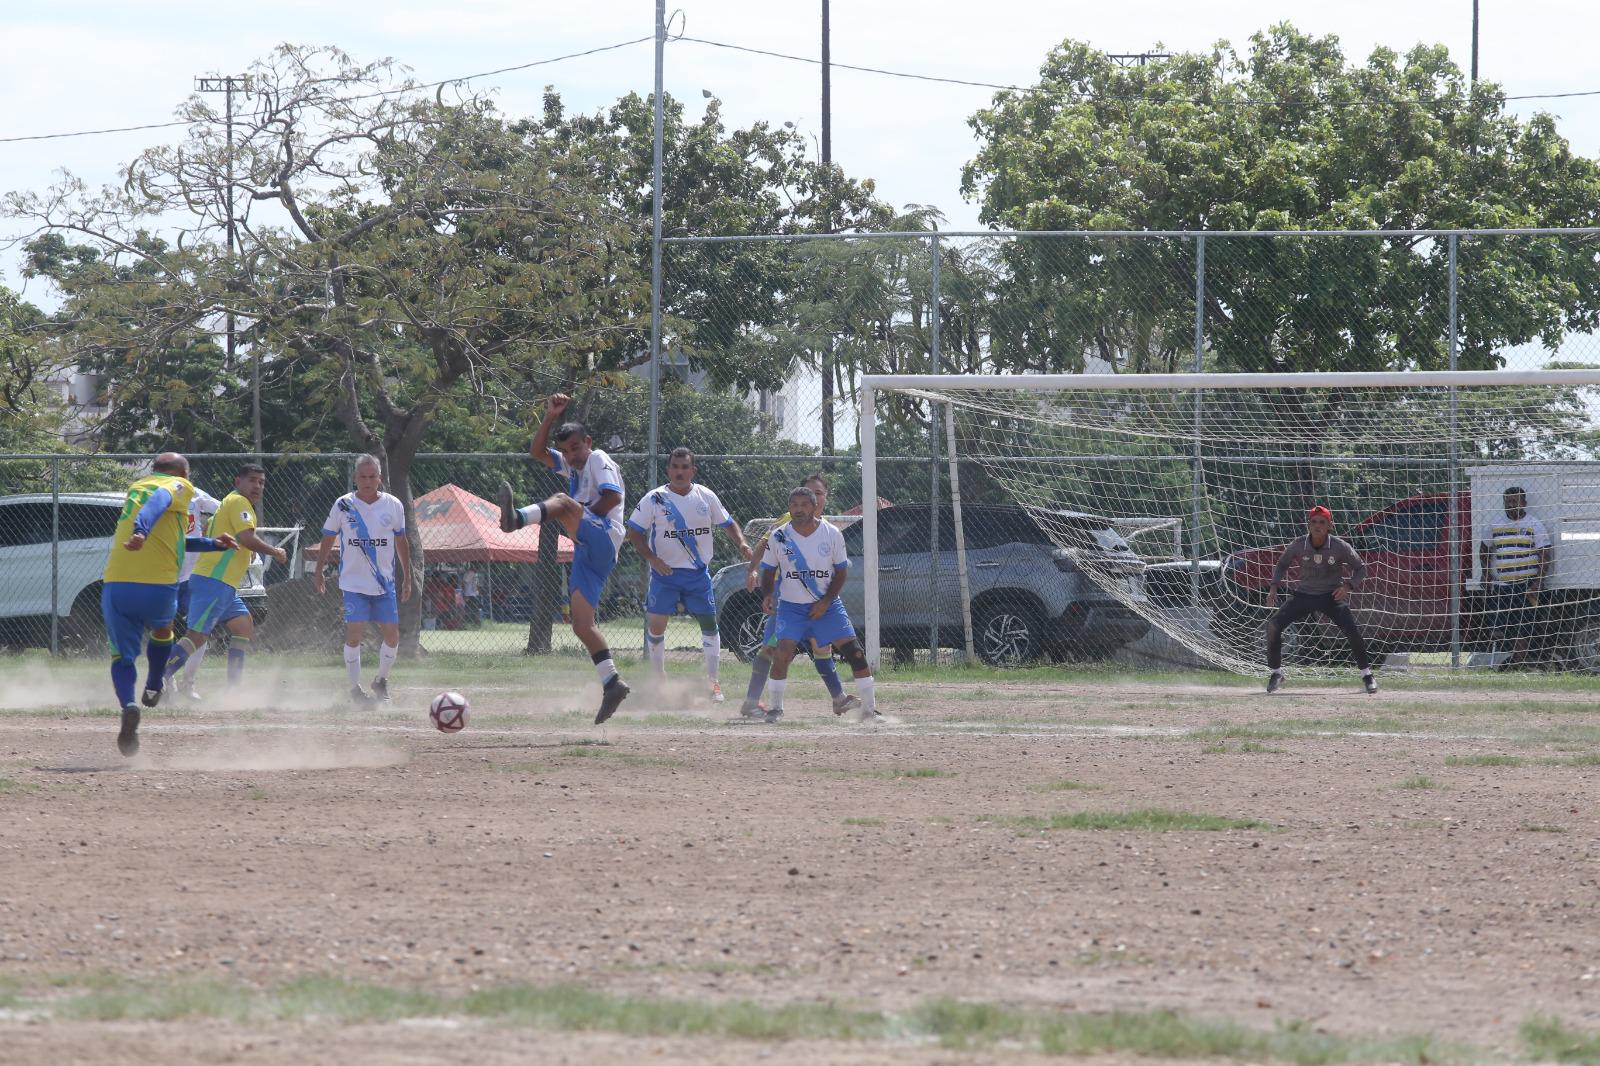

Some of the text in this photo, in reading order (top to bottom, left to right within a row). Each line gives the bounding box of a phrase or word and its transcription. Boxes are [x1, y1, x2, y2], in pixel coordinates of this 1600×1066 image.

[663, 528, 710, 539] ASTROS
[348, 538, 388, 547] ASTROS
[785, 569, 830, 579] ASTROS
